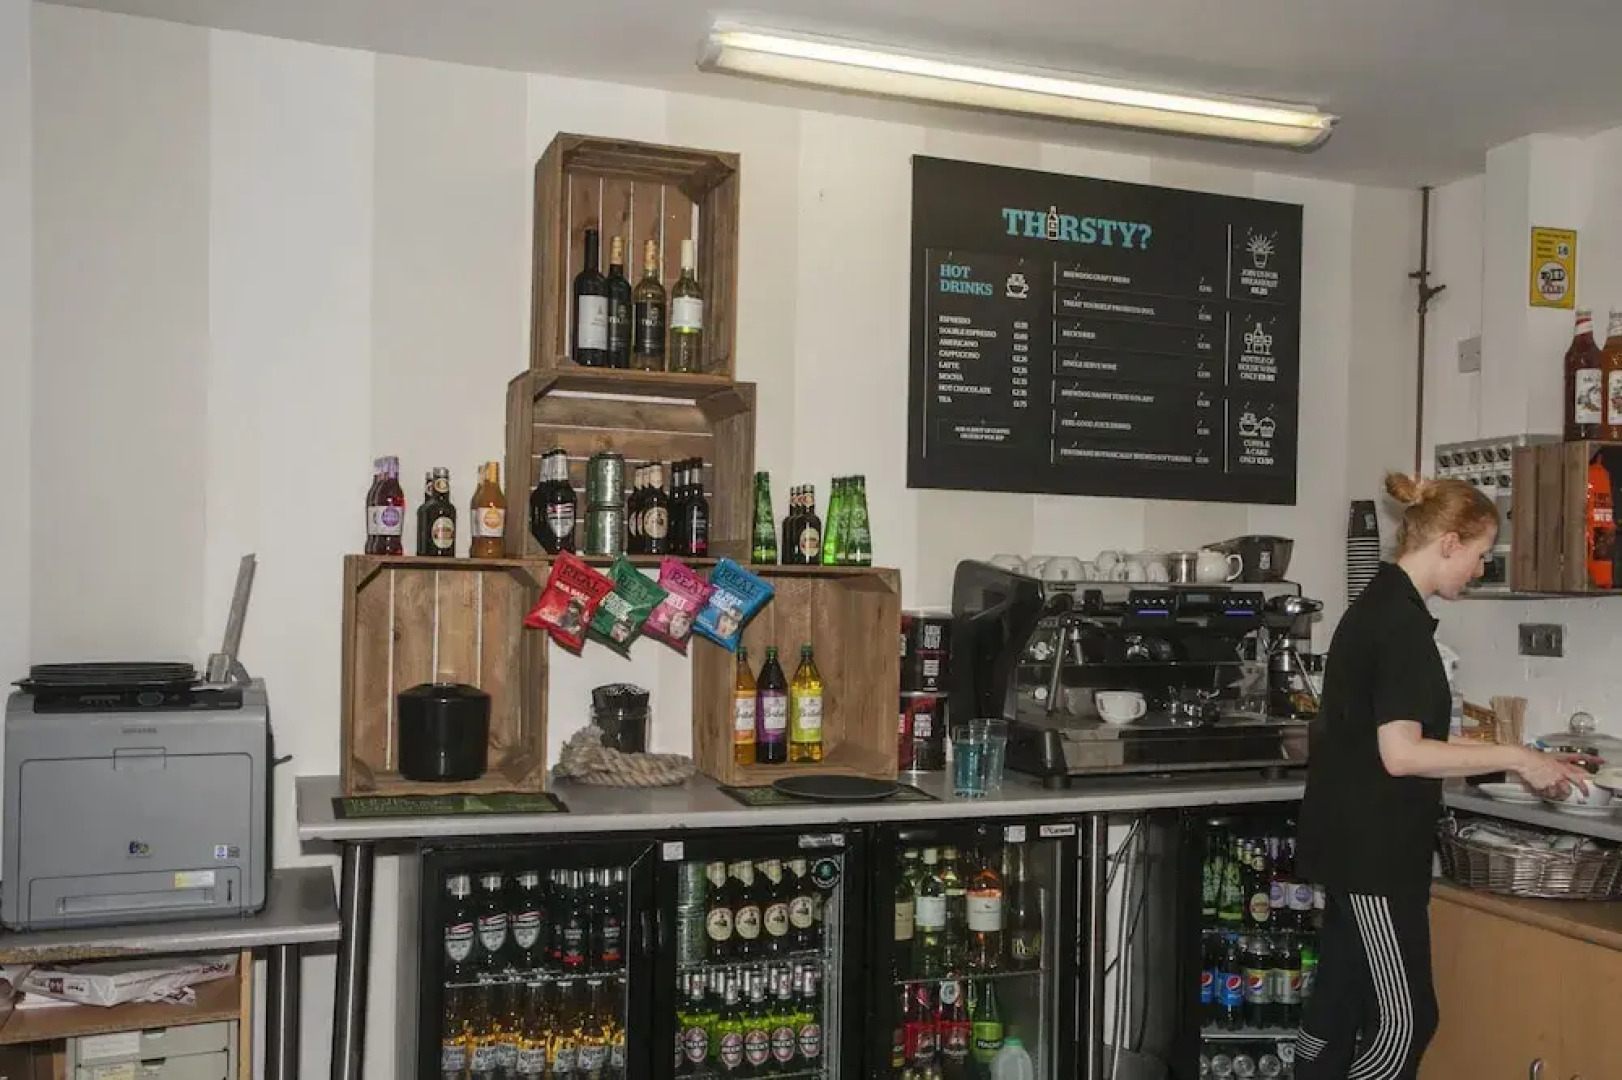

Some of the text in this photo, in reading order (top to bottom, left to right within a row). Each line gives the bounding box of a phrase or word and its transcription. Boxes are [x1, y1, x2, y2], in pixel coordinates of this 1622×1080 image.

[940, 264, 971, 278] HOT
[940, 279, 993, 295] DRINKS
[939, 315, 971, 325] ESPRESSO
[939, 327, 996, 338] DOUBLE ESPRESSO
[939, 339, 979, 348] AMERICANO
[939, 350, 980, 360] CAPPUCCINO
[939, 361, 960, 370] LATTE
[939, 373, 963, 381] MOCHA
[939, 384, 953, 392] HOT
[953, 385, 991, 394] CHOCOLATE
